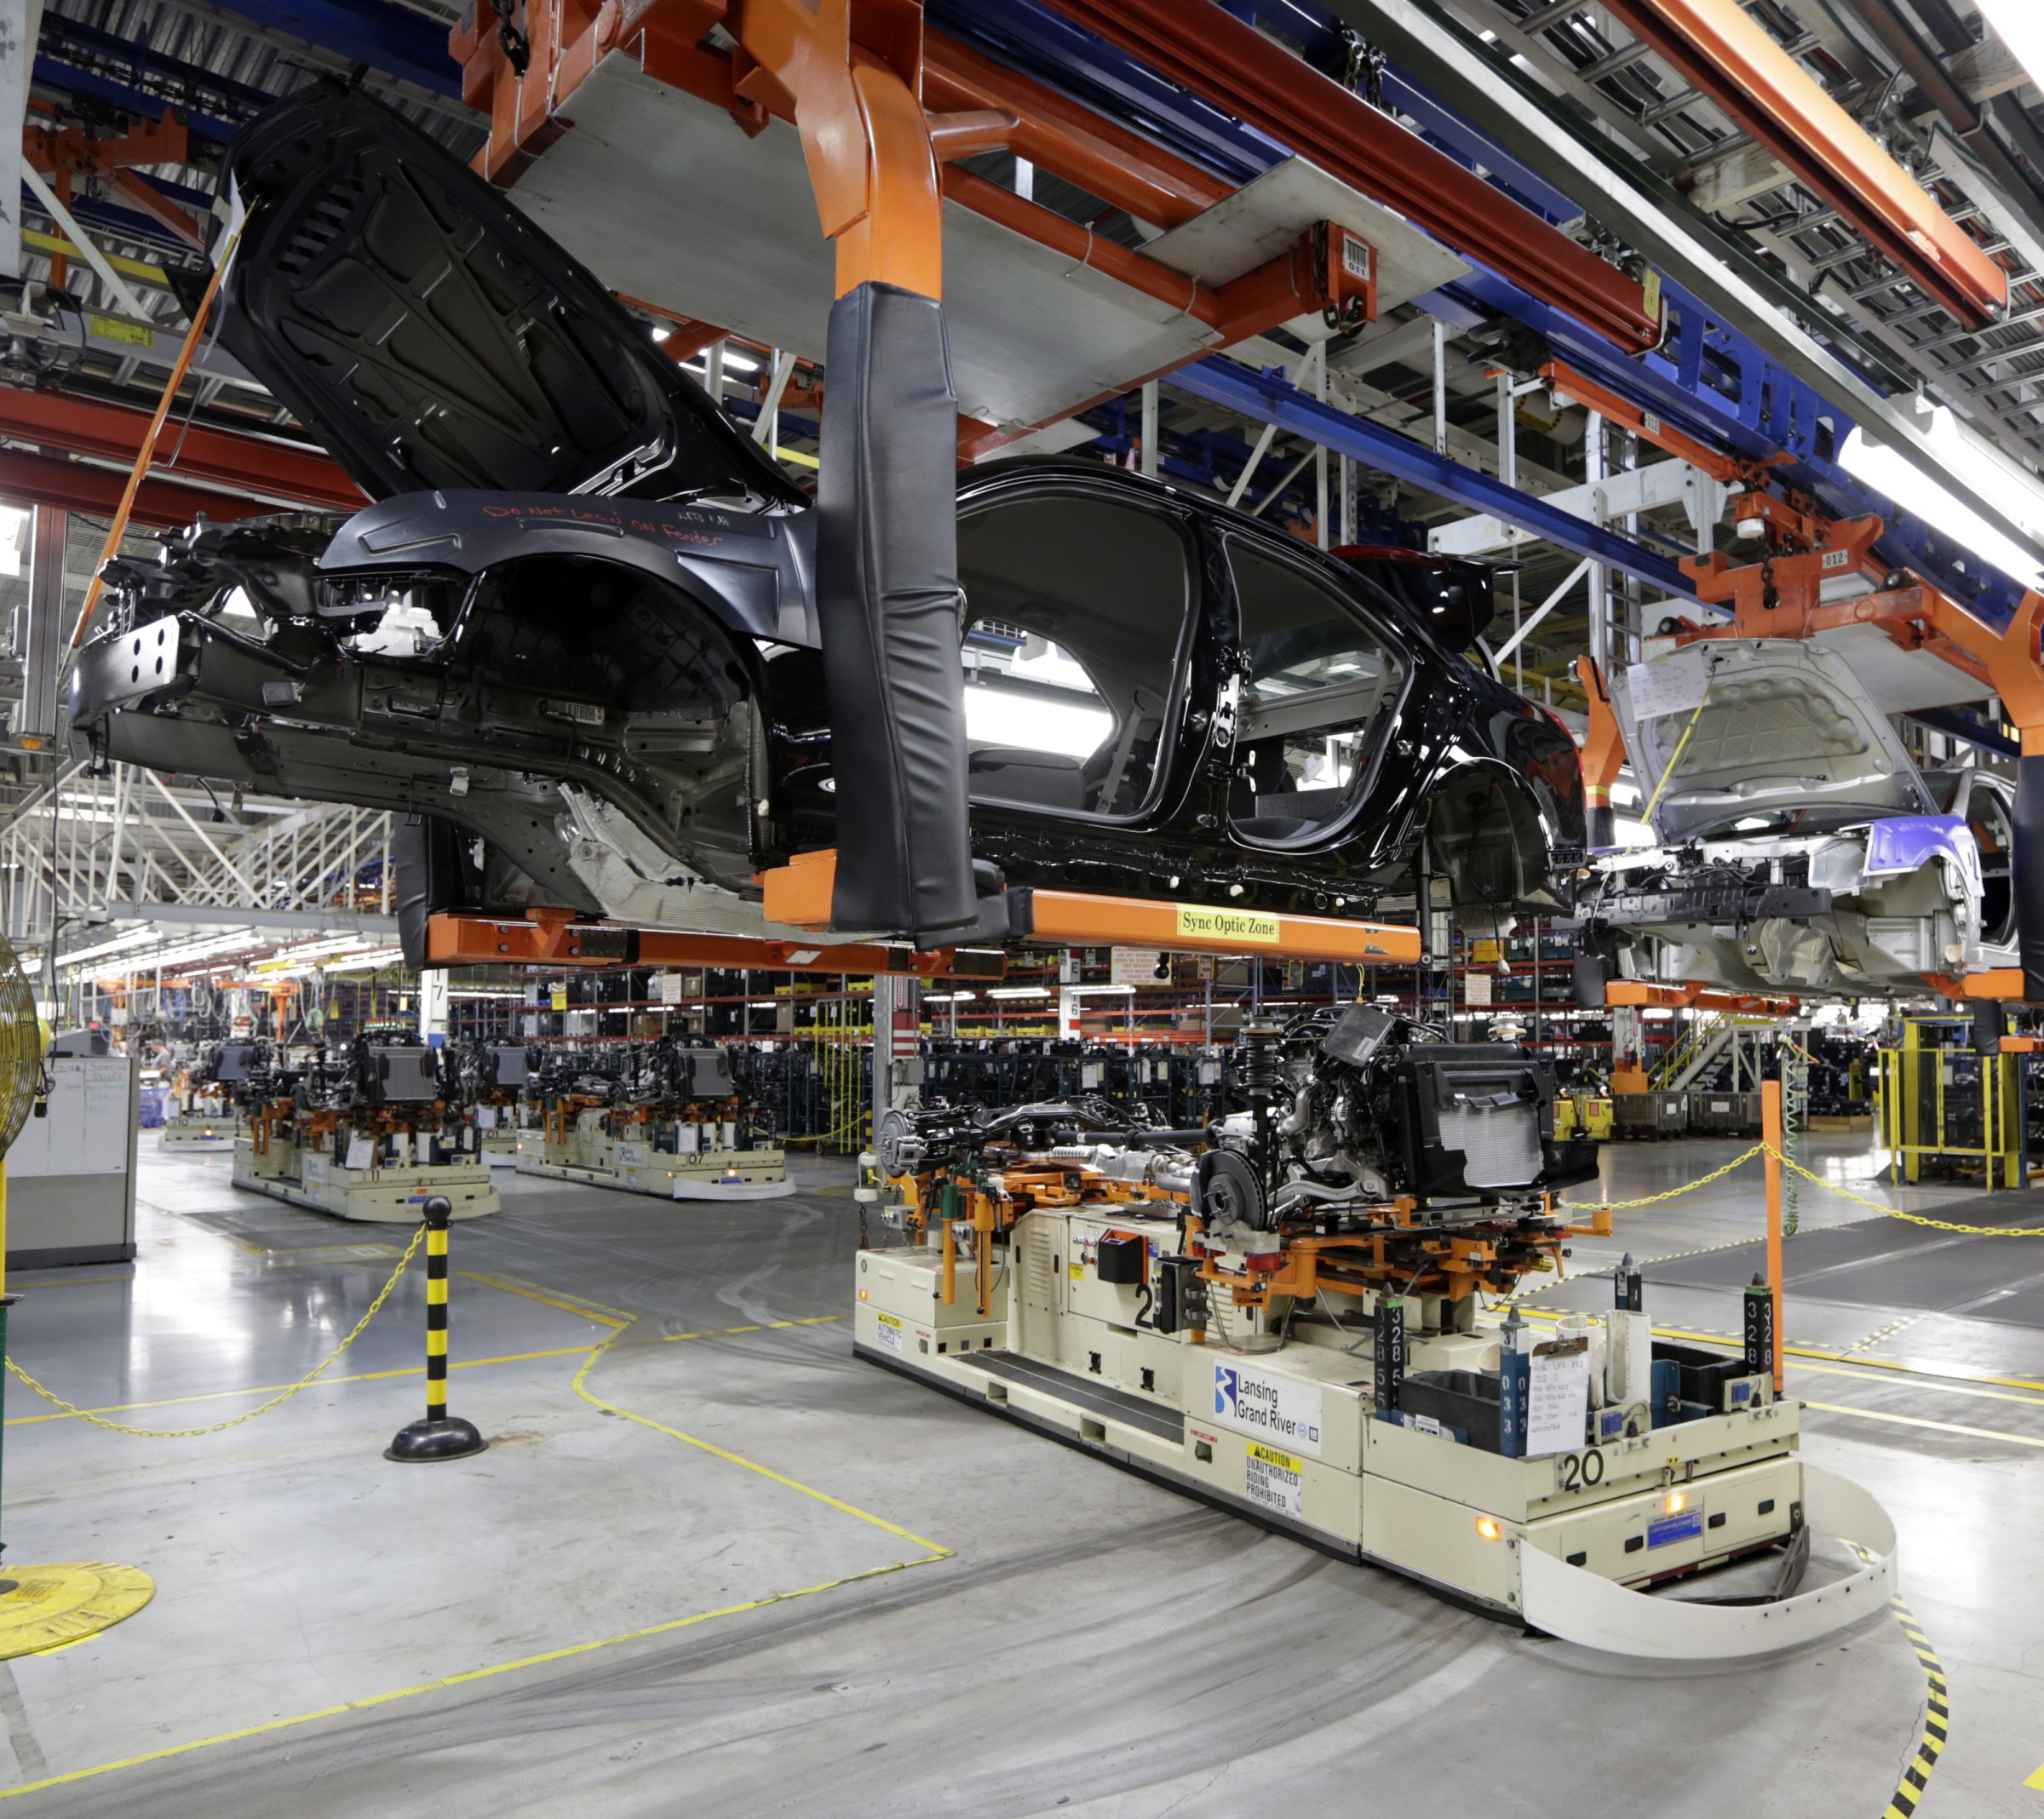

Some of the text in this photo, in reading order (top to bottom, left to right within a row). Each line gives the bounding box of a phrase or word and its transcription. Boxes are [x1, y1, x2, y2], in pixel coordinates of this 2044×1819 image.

[1349, 262, 1364, 276] 011
[1826, 553, 1843, 565] 012
[1183, 912, 1275, 935] Sync Optic Zone
[1071, 961, 1078, 974] E
[688, 1153, 704, 1165] 07
[1237, 1374, 1278, 1409] Lansing
[1237, 1399, 1296, 1436] Grand River
[1260, 1447, 1291, 1469] CAUTION
[1247, 1456, 1298, 1487] UNAUTHORIZED
[1247, 1469, 1270, 1489] RIDING
[1565, 1449, 1604, 1492] 20
[1246, 1482, 1286, 1508] PROHIBITED
